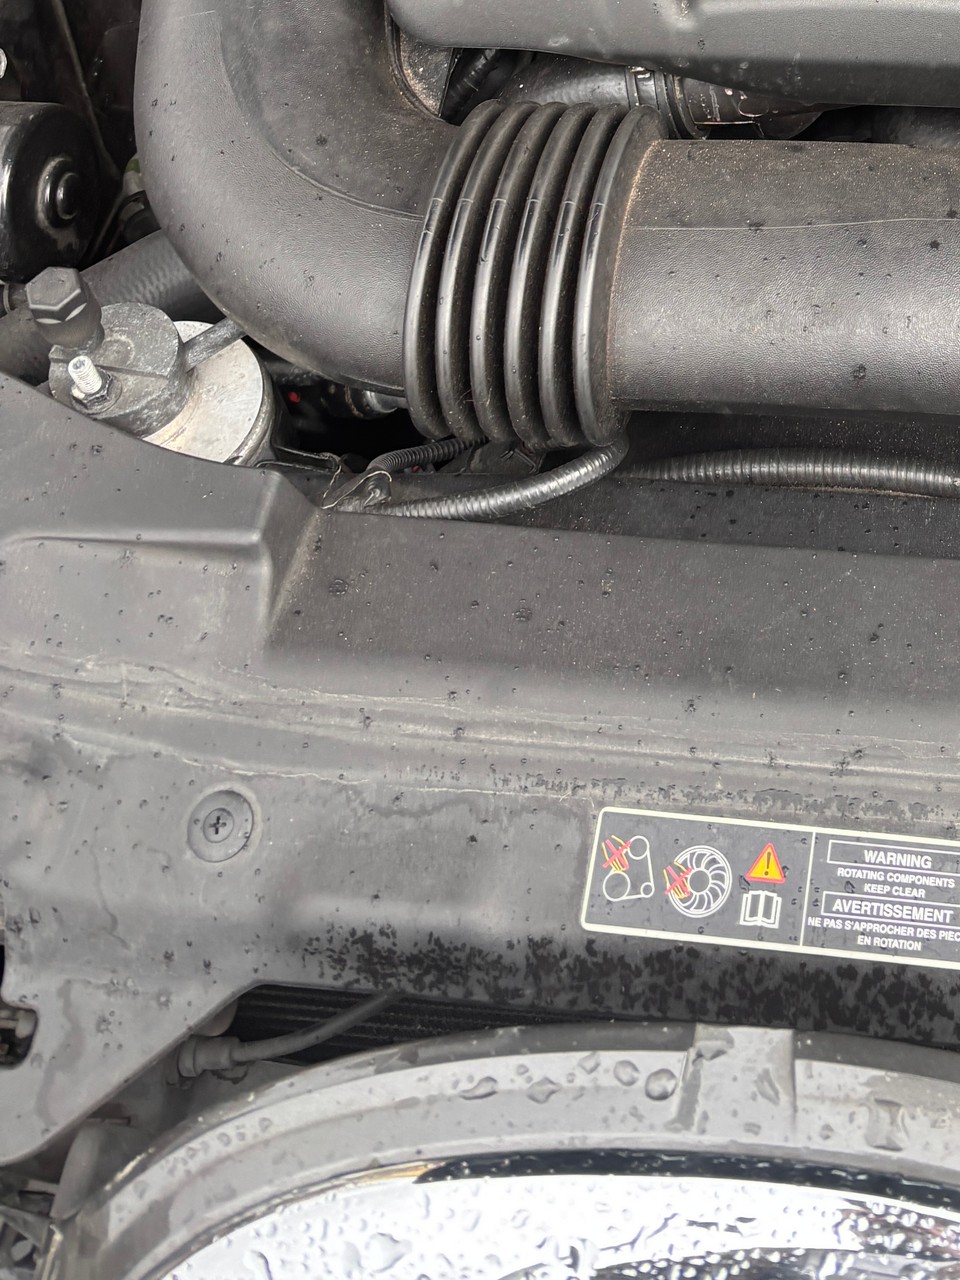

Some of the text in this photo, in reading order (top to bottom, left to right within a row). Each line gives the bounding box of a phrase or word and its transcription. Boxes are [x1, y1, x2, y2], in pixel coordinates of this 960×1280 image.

[863, 849, 933, 870] WARNING
[836, 867, 956, 889] ROTATING COMPONENTS
[863, 883, 926, 899] KEEP CLEAR
[832, 898, 954, 924] AVERTISSEMENT
[807, 916, 822, 927] NE
[823, 918, 843, 930] PAS
[844, 920, 915, 938] S'APPROCHER
[915, 928, 937, 940] DES
[857, 934, 922, 952] EN ROTATION
